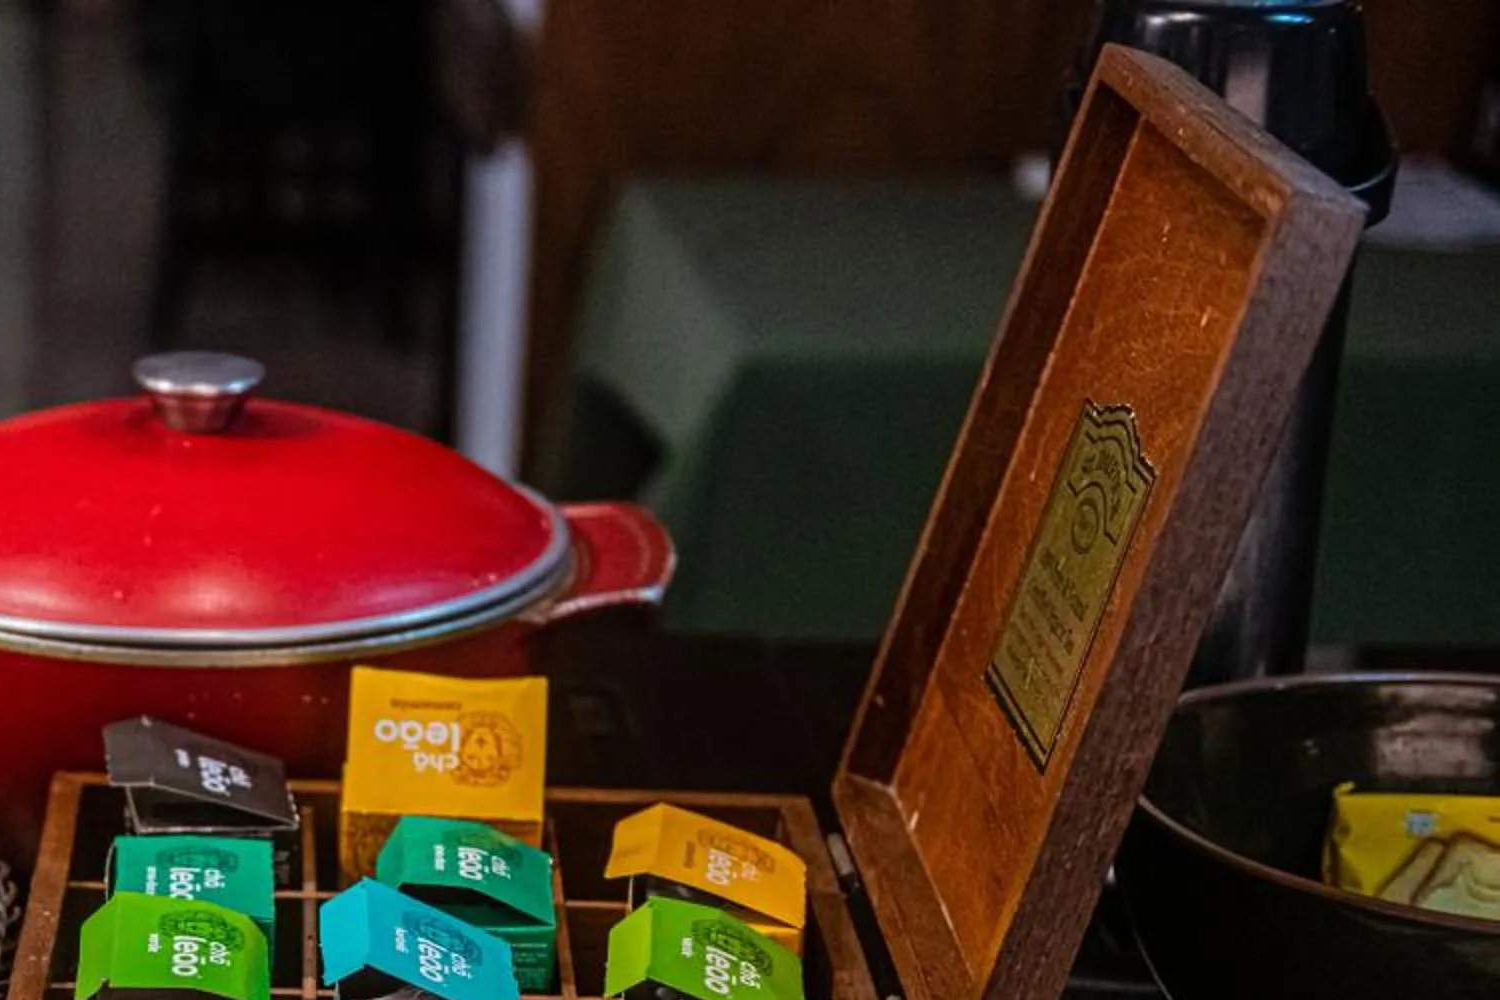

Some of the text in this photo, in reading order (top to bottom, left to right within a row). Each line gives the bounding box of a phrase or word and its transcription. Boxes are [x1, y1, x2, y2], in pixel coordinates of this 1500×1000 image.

[374, 719, 460, 750] leão
[413, 752, 459, 774] chá
[457, 846, 489, 881] leão
[171, 935, 208, 977] leão
[209, 941, 232, 967] chá
[417, 937, 450, 983] leão
[704, 945, 738, 995] leão
